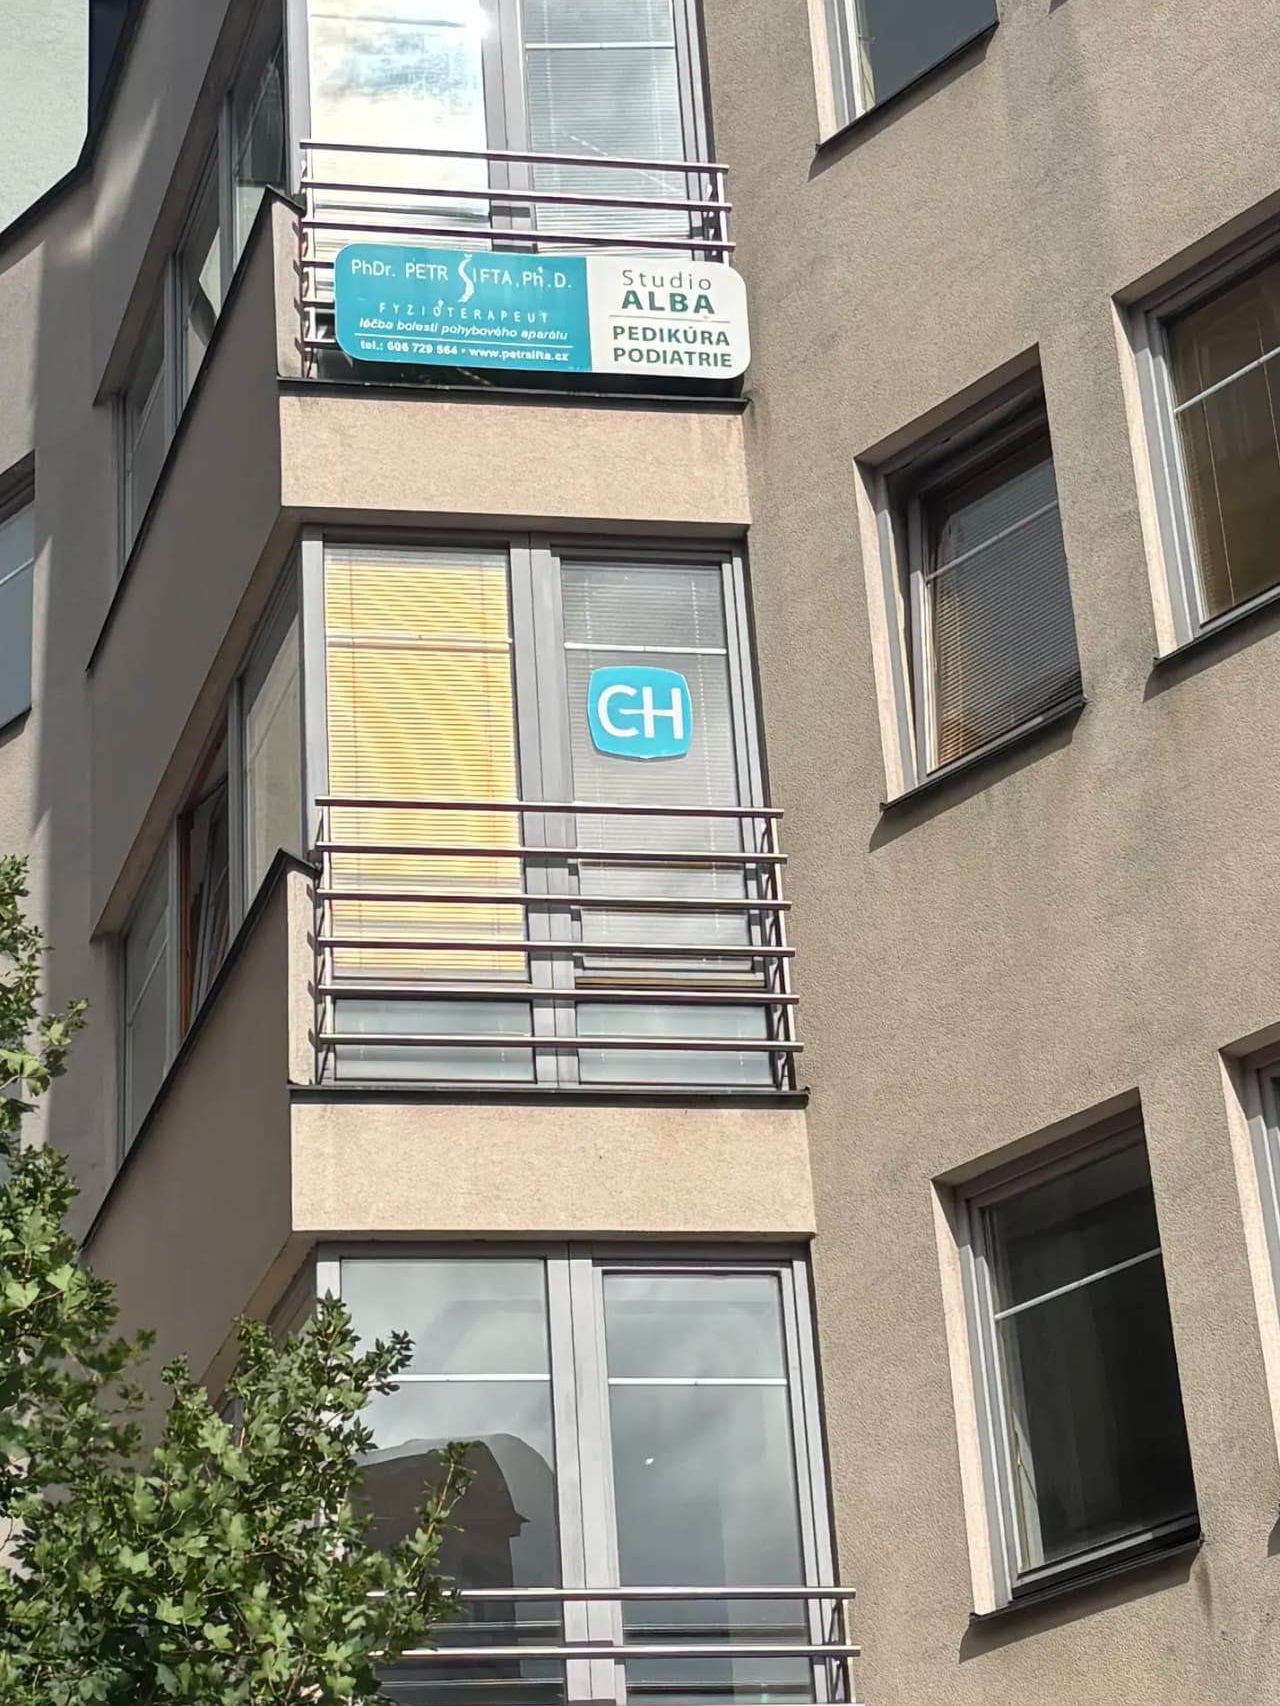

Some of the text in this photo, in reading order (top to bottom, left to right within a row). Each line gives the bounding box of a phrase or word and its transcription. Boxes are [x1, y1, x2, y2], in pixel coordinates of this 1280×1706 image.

[352, 259, 396, 278] PhDr.
[405, 263, 448, 281] PETR
[622, 269, 711, 290] Studio
[621, 290, 715, 314] ALBA
[613, 325, 730, 346] PEDIKÚRA
[613, 347, 732, 368] PODIATRIE
